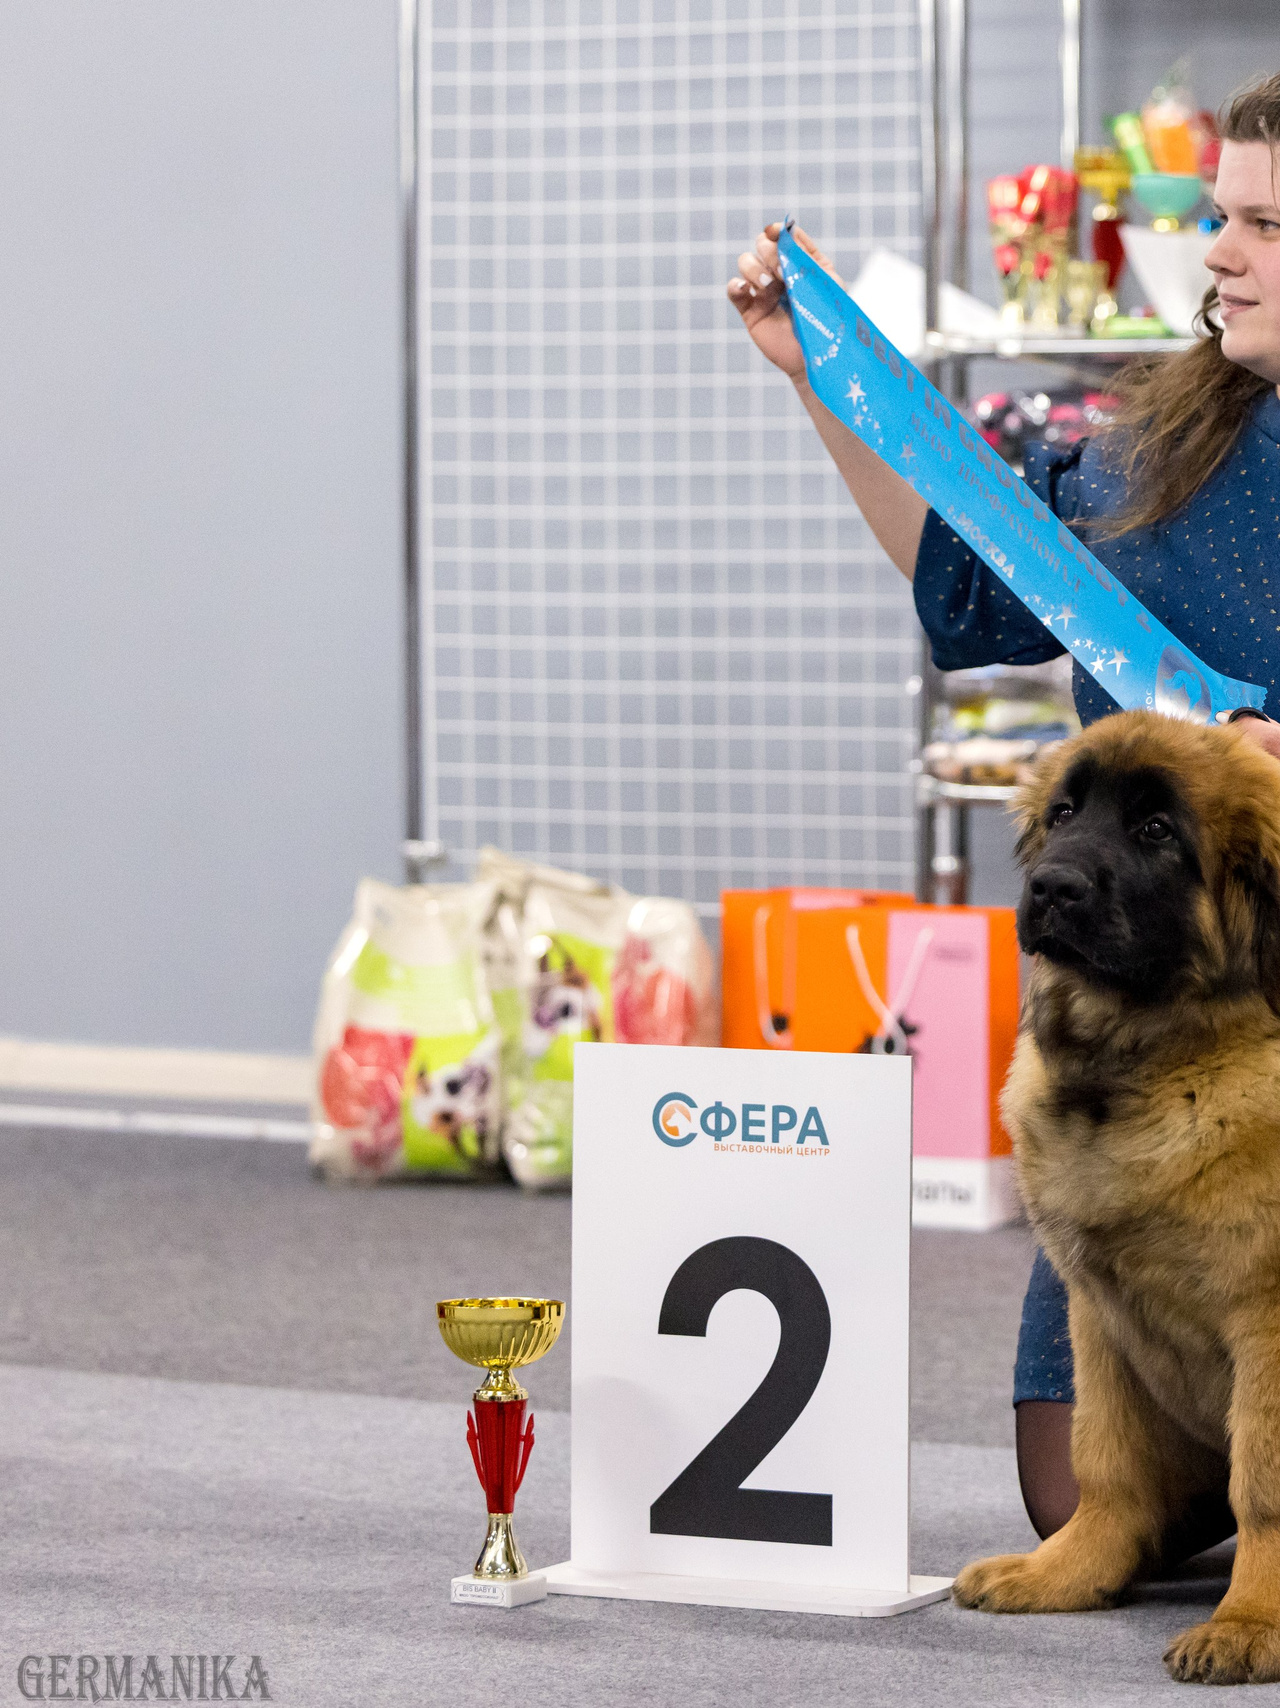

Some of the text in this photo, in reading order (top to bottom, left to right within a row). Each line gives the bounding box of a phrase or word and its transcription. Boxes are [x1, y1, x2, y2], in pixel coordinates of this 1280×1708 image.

[856, 315, 917, 393] BEST
[924, 386, 951, 430] IN
[959, 422, 1049, 522] GROUP
[1057, 522, 1128, 607] BABY
[652, 1091, 830, 1147] СФЕРА
[713, 1143, 830, 1157] ВЫСТАВОЧНЫЙ ЦЕНТР
[650, 1236, 833, 1547] 2
